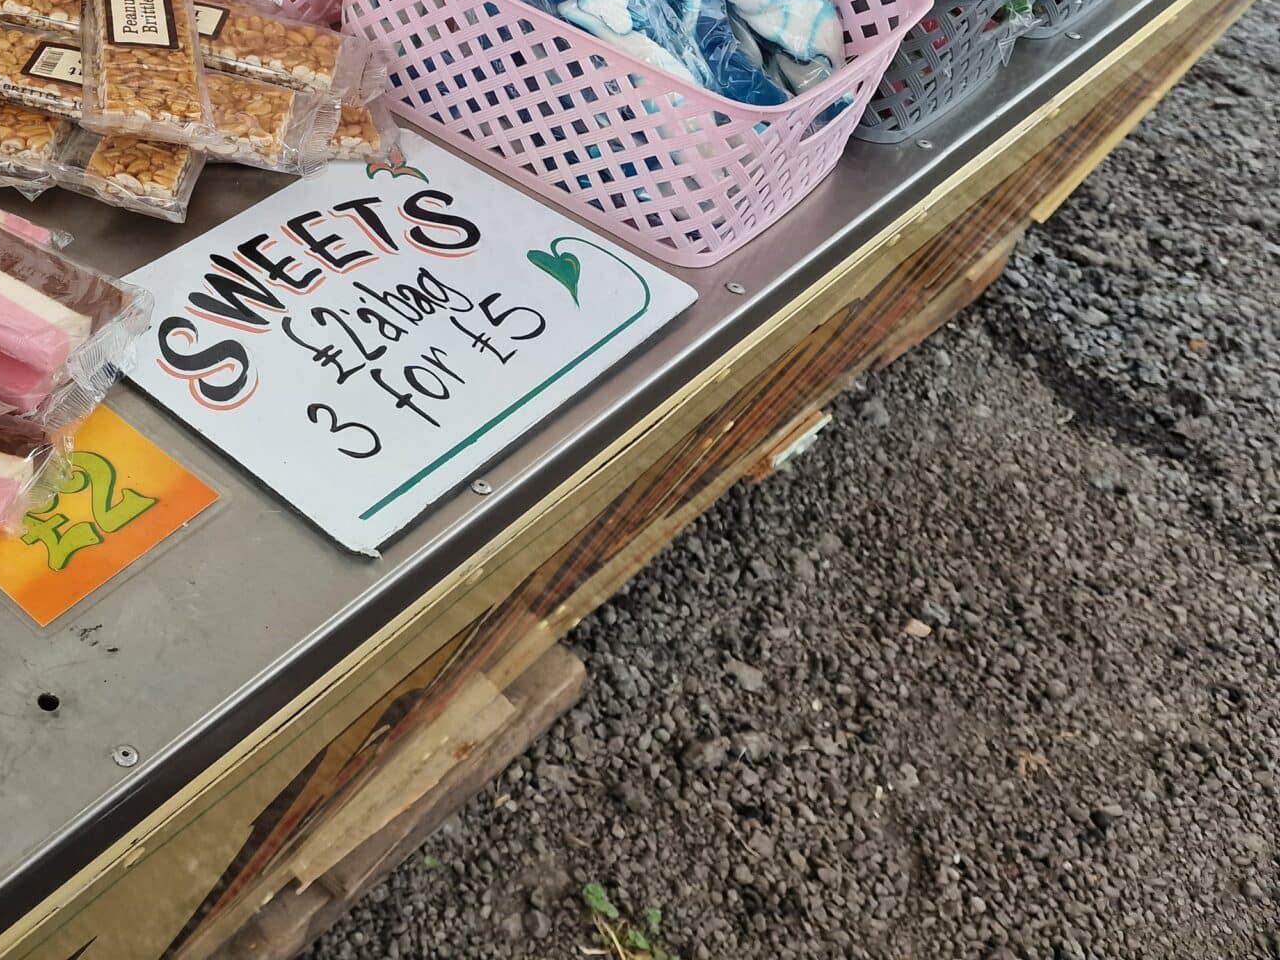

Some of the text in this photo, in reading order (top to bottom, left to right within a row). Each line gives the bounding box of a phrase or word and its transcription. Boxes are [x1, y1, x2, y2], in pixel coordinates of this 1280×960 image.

[157, 189, 482, 408] SWEETS
[281, 306, 388, 385] £2
[306, 292, 547, 459] 3 for £5
[20, 451, 160, 571] £2
